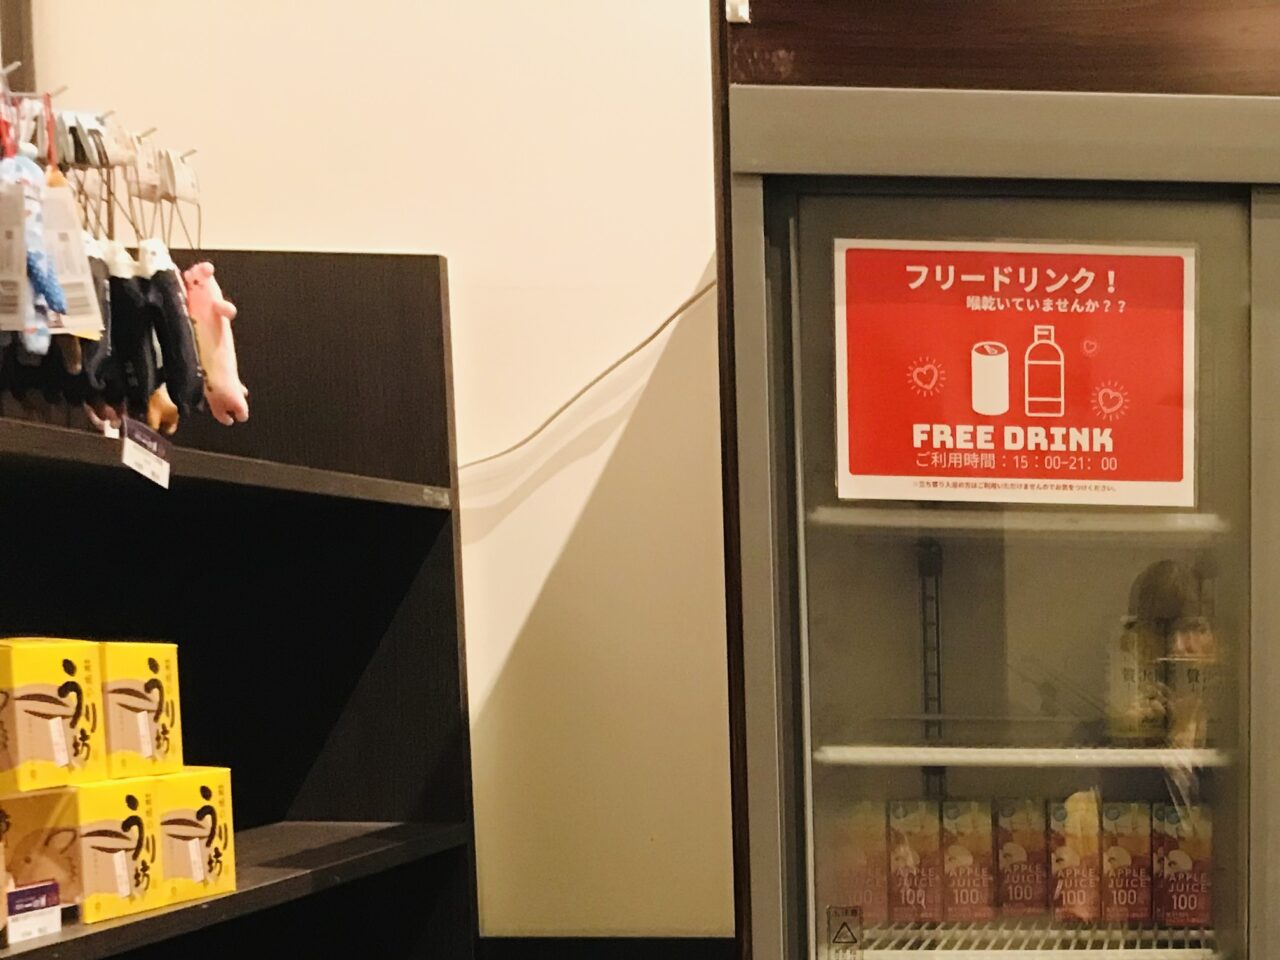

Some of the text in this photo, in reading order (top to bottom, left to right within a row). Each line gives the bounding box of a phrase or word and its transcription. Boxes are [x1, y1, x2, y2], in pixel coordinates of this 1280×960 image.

[906, 264, 1116, 293] フリードリンク！
[913, 423, 1114, 453] FREE DRINK
[1005, 864, 1042, 873] APPLE
[1058, 868, 1095, 878] APPLE
[1109, 868, 1145, 878] APPLE
[1168, 873, 1206, 882] APPLE
[1008, 885, 1032, 900] 100
[1168, 884, 1207, 893] JUICE
[953, 889, 979, 904] 100
[1061, 890, 1086, 905] 100
[1111, 890, 1137, 905] 100
[1172, 894, 1197, 910] 100
